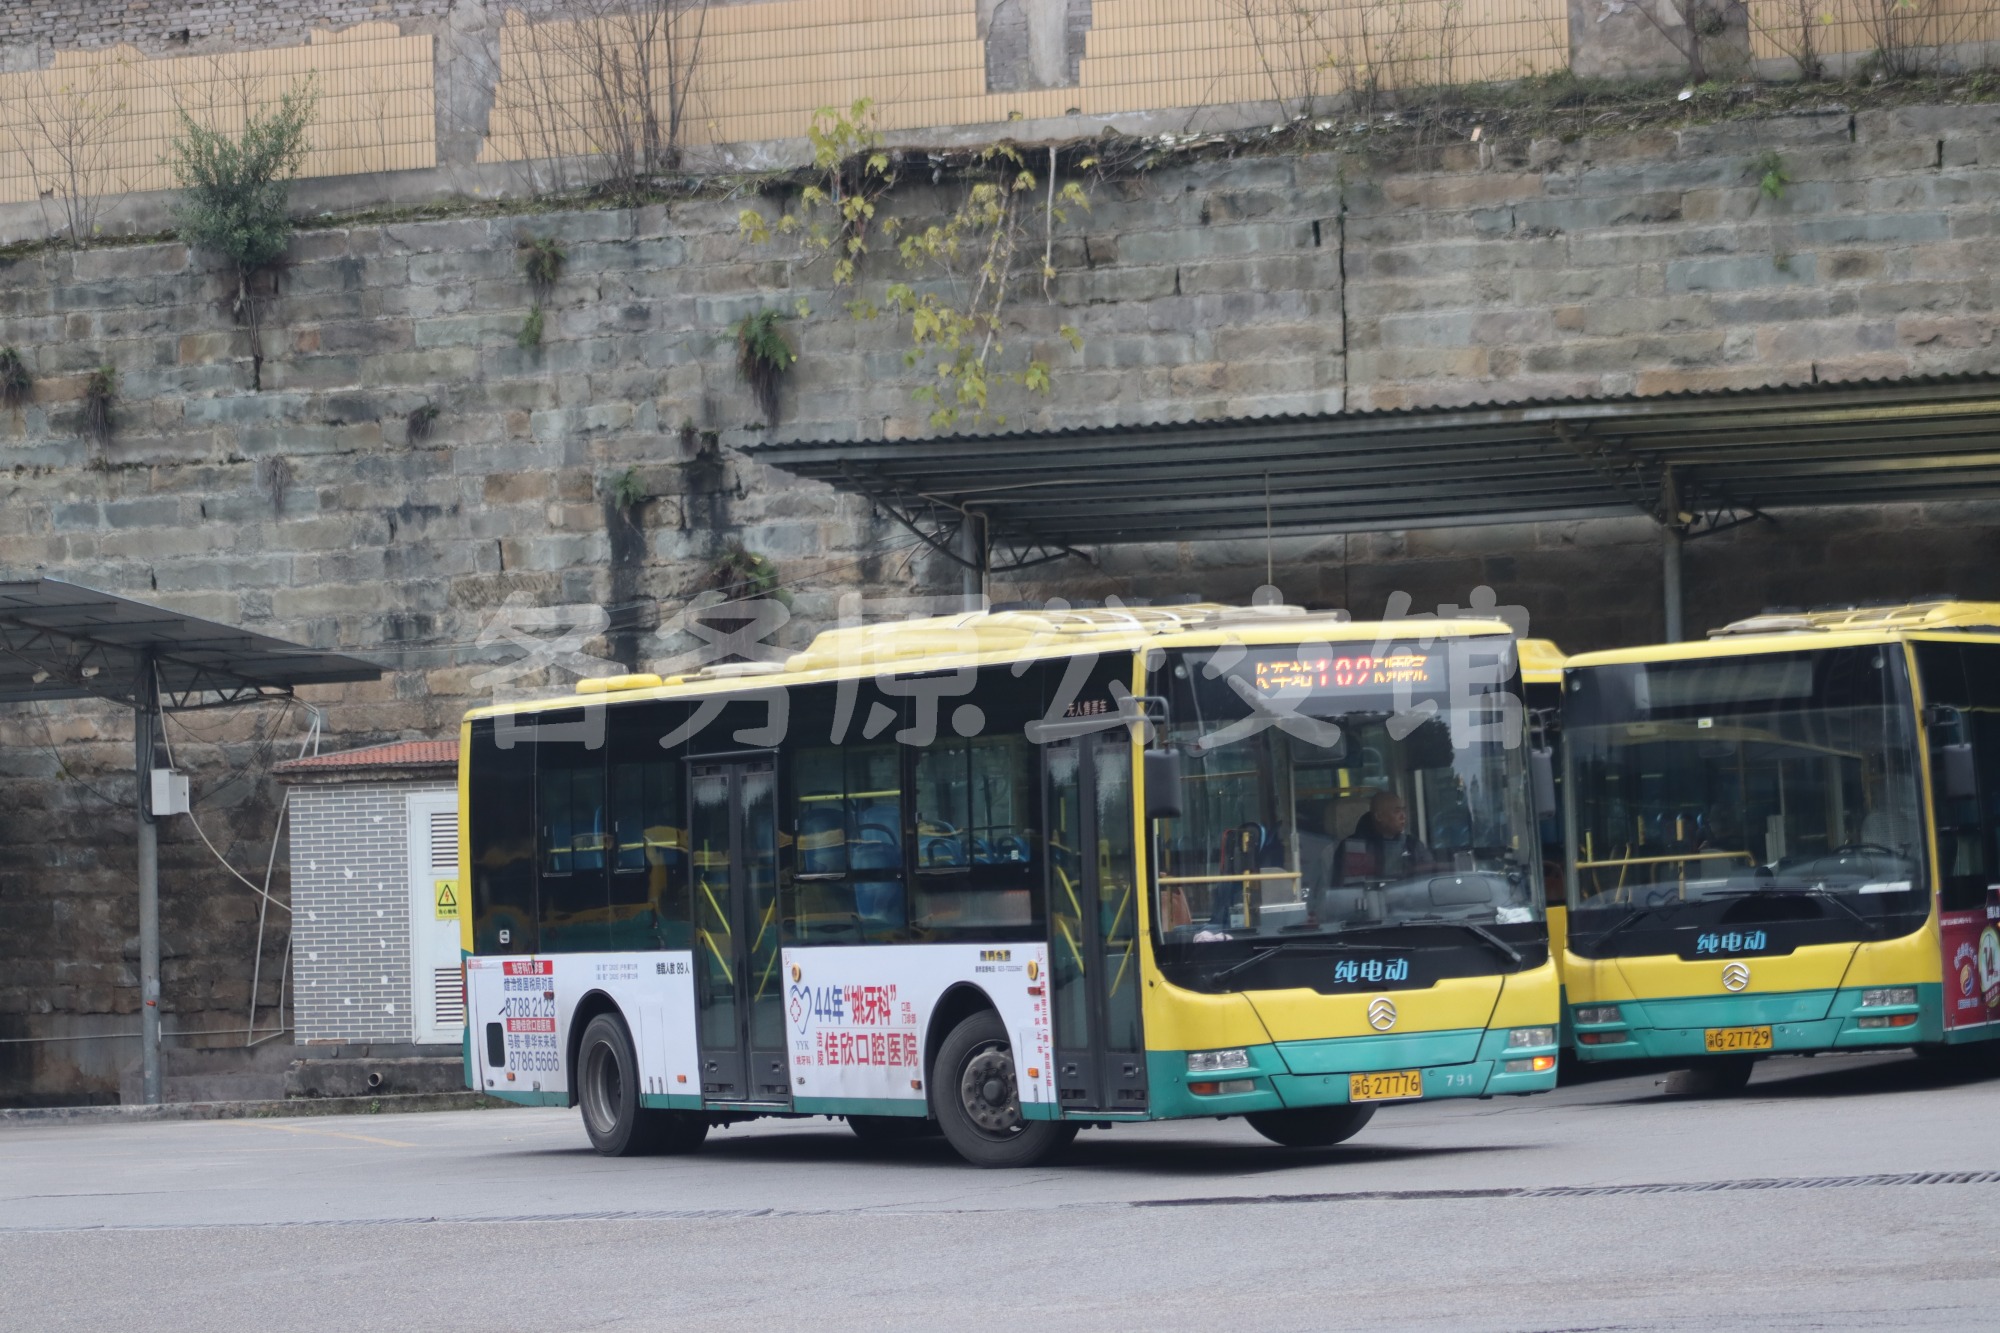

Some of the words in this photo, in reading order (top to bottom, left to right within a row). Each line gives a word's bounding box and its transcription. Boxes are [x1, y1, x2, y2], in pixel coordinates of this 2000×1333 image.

[1067, 699, 1107, 717] 无人售票车
[1696, 930, 1768, 954] 纯电动
[1333, 958, 1409, 983] 纯电动
[510, 1019, 552, 1032] 涪陵佳欣口腔医院
[795, 1040, 810, 1051] YYK
[825, 1032, 919, 1067] 佳欣口腔医院
[1446, 1073, 1473, 1087] 791
